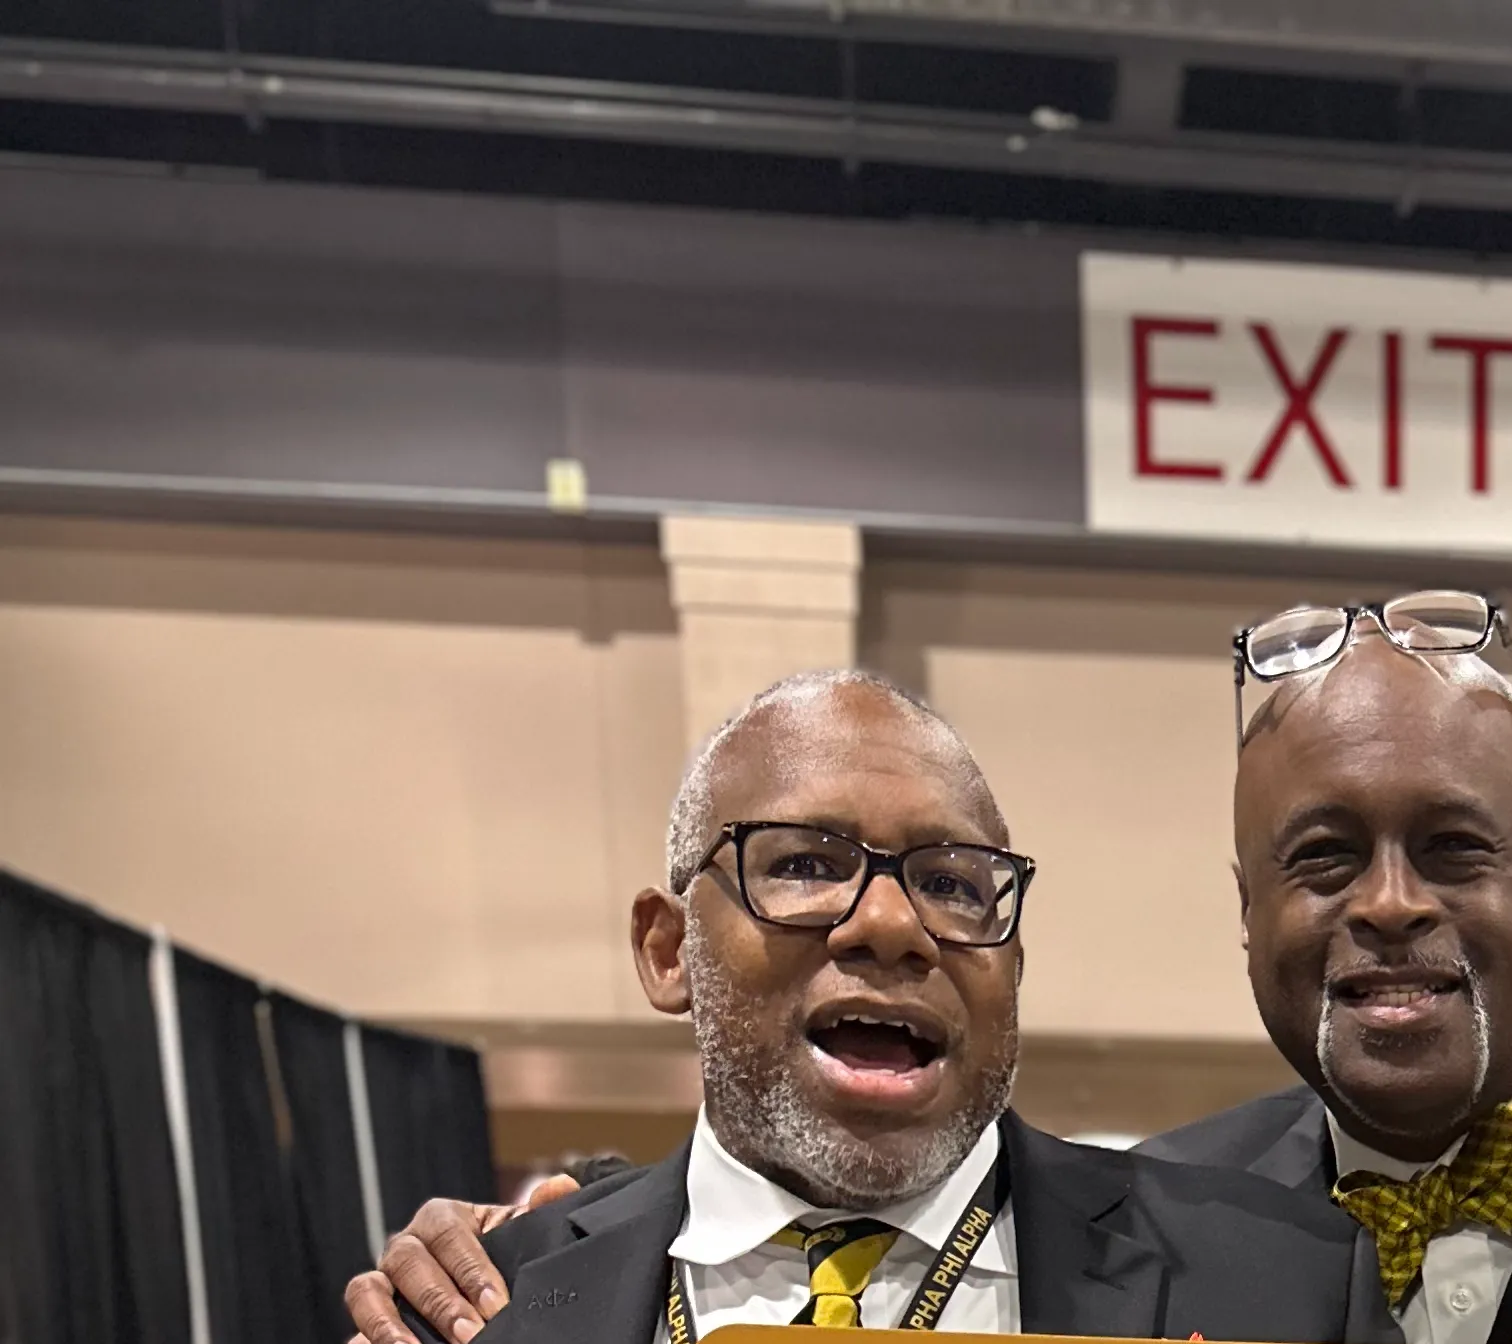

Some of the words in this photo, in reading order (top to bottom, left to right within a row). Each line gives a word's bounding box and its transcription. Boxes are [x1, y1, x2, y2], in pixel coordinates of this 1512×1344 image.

[908, 1289, 947, 1330] PHA
[932, 1251, 965, 1289] PHI
[952, 1206, 993, 1258] ALPHA
